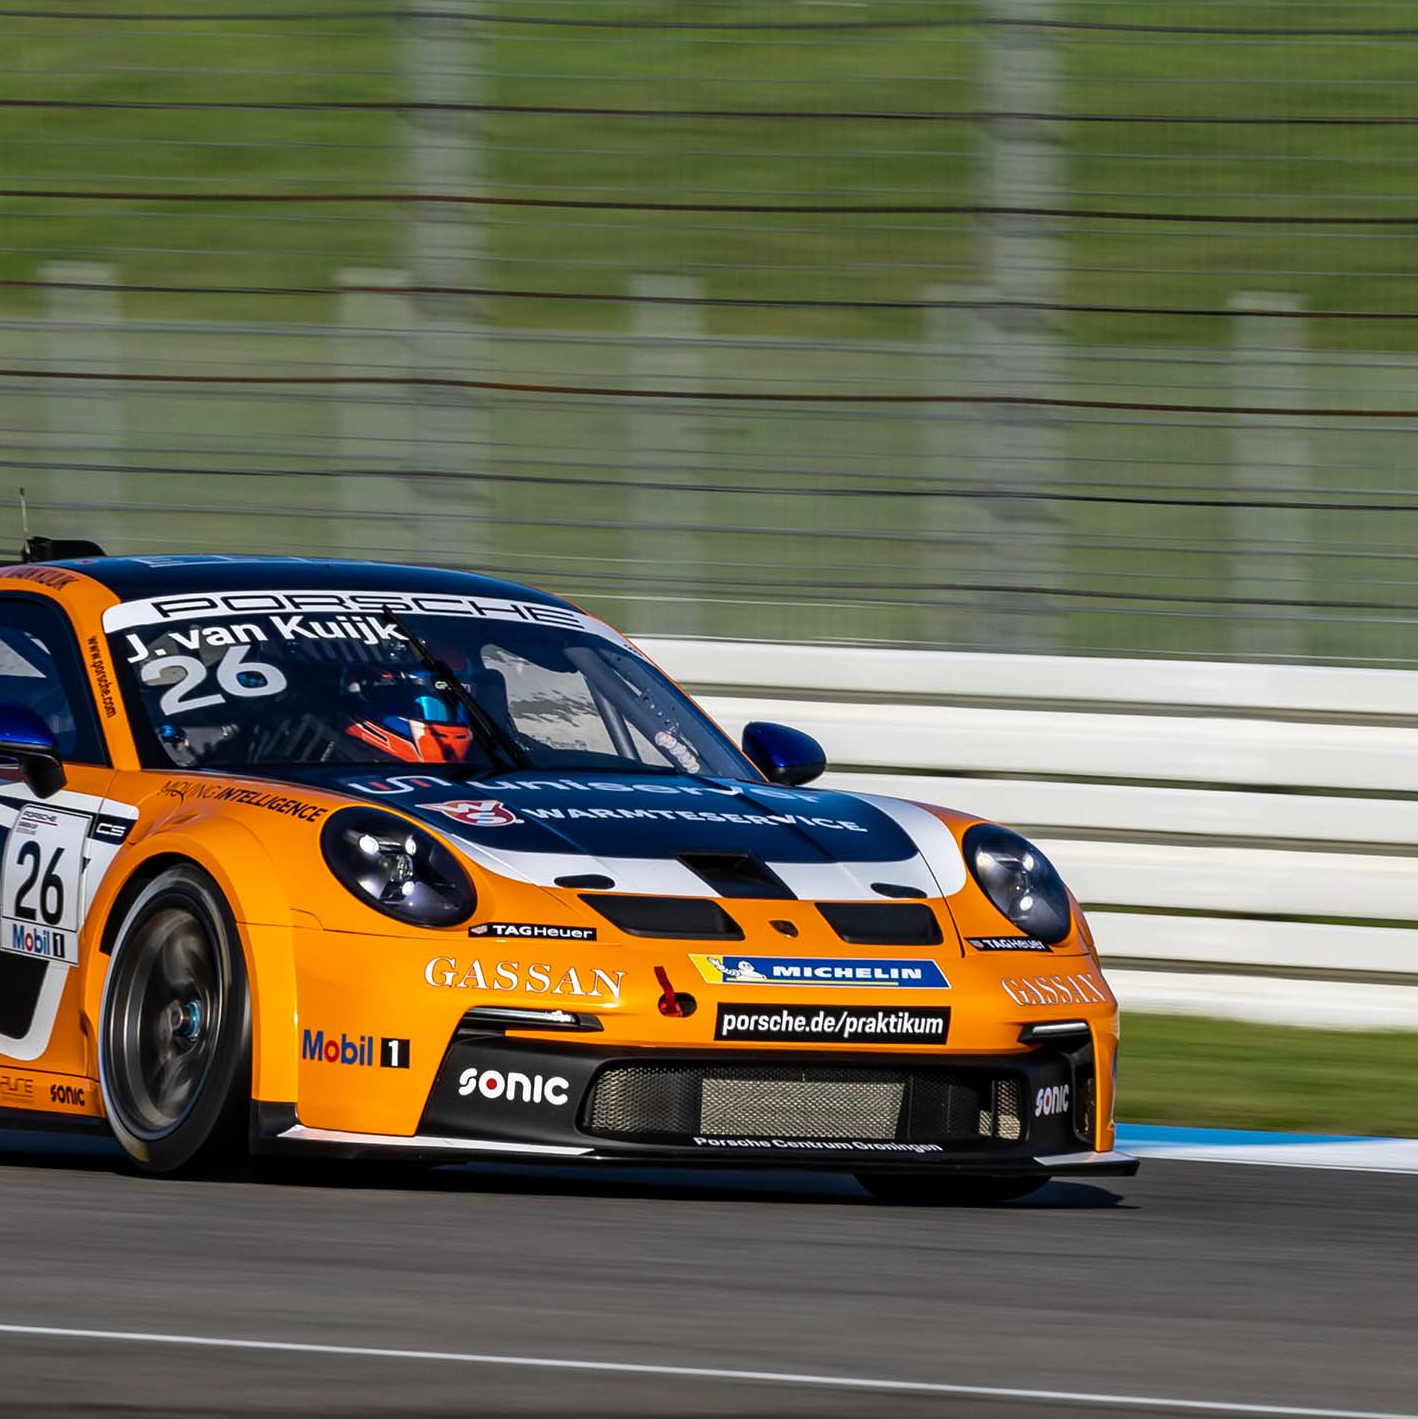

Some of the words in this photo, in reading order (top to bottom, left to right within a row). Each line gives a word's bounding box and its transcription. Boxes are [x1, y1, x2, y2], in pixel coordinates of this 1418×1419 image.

[151, 594, 586, 630] PORSCHE
[126, 633, 169, 664] J.
[168, 623, 270, 649] van
[269, 615, 410, 645] Kuijk
[87, 635, 117, 718] www.porsche.com
[140, 645, 288, 716] 26
[213, 786, 329, 823] INTELLIGENCE
[466, 779, 823, 804] uniserver
[23, 810, 59, 823] PORSCHE
[519, 808, 869, 833] WARMTESERVICE
[14, 840, 65, 926] 26
[12, 923, 51, 956] Mobil
[424, 956, 628, 1000] GASSAN
[772, 965, 923, 980] MICHELIN
[1000, 973, 1107, 1006] GASSAN
[722, 1009, 945, 1039] porsche.de/praktikum
[301, 1029, 374, 1066] Mobil
[693, 1136, 772, 1149] Porsche
[772, 1138, 854, 1151] Centrum
[851, 1140, 944, 1154] Groningen
